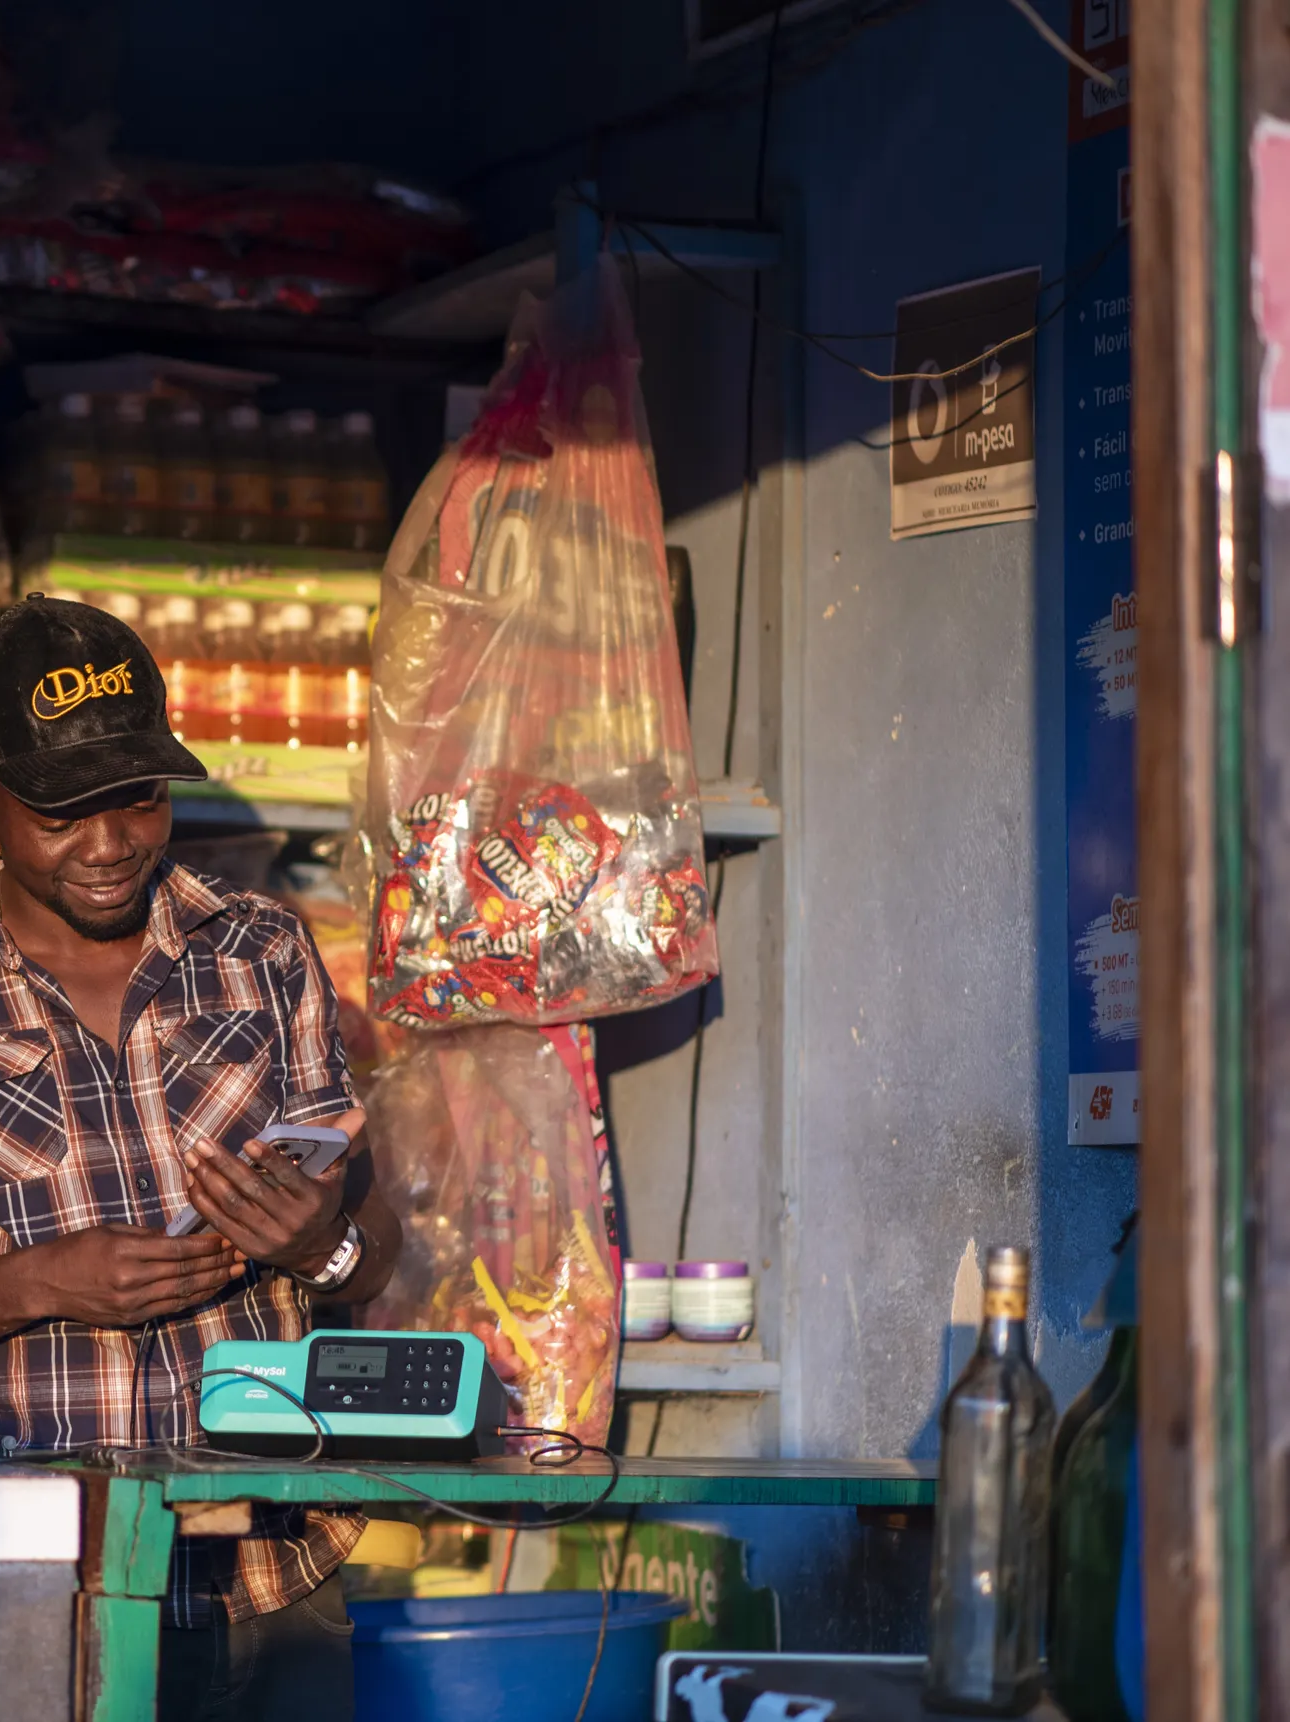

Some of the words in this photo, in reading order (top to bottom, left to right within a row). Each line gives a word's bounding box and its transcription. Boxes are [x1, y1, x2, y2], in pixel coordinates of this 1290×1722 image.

[1093, 294, 1133, 323] Trans
[1093, 326, 1133, 357] Movit
[1093, 382, 1133, 408] Trans
[965, 423, 1015, 463] m-pesa
[1094, 431, 1127, 460] Fácil
[964, 474, 988, 494] 45242
[1094, 473, 1122, 494] sem
[1094, 516, 1135, 545] Grand
[1112, 592, 1138, 632] Int
[1114, 649, 1124, 665] 12
[46, 662, 134, 708] Dior
[1114, 675, 1125, 691] 50
[1111, 895, 1139, 934] Sem
[1102, 956, 1117, 972] 500
[1117, 952, 1129, 970] MT
[253, 1366, 286, 1377] MySol
